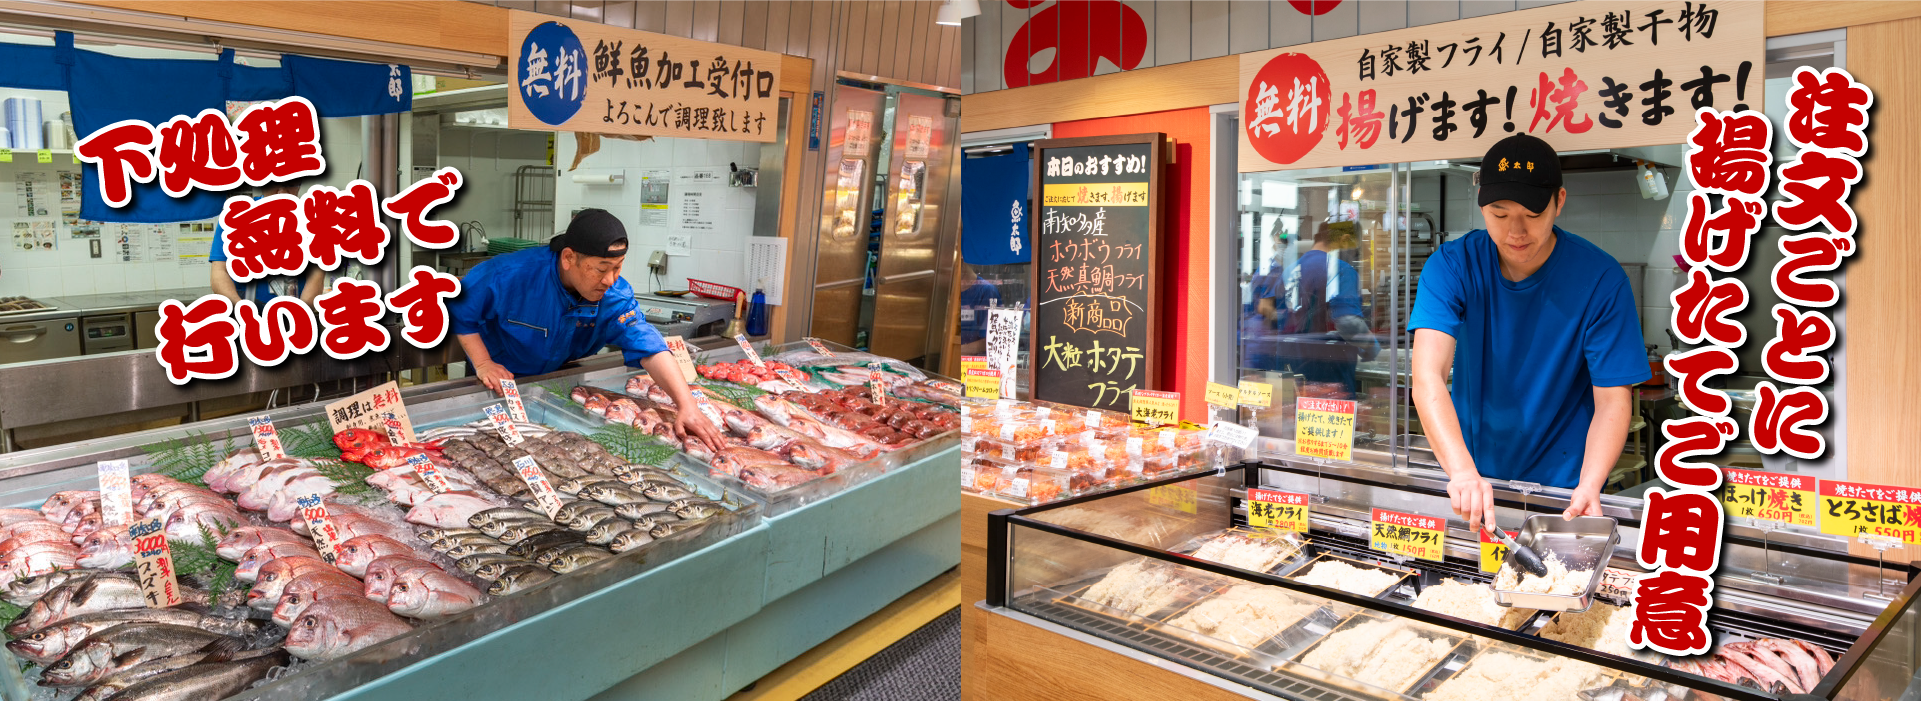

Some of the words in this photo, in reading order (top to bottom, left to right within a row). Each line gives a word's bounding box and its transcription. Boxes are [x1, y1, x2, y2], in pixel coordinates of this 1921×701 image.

[522, 42, 582, 101] 無料
[593, 39, 774, 101] 鮮魚加工受付口
[603, 98, 767, 135] よろこんで調理致します
[1248, 75, 1323, 139] 無料
[1043, 207, 1108, 237] 南知多産
[1045, 262, 1145, 294] 天然真鯛フライ
[1066, 299, 1123, 332] 新商品
[332, 387, 399, 426] 調理は無料
[1087, 381, 1137, 411] フライ
[1135, 406, 1174, 421] 大海老フライ
[1298, 411, 1353, 426] 揚げたて、焼きたて
[1726, 470, 1802, 489] 焼きたてをご提供
[1255, 491, 1302, 504] 揚げたてをご提供
[1722, 485, 1803, 512] ほっけ焼き
[1835, 484, 1921, 504] 焼きたてをご提供
[1251, 501, 1302, 520] 海老フライ
[1379, 511, 1436, 529] 揚げたてをご提供
[1758, 508, 1793, 523] 650円
[1275, 519, 1296, 530] 280円
[1374, 523, 1439, 546] 天然鯛フライ
[1874, 526, 1915, 543] 550円
[133, 534, 171, 555] 3000円
[1402, 544, 1426, 558] 150円
[138, 561, 160, 606] スズキ
